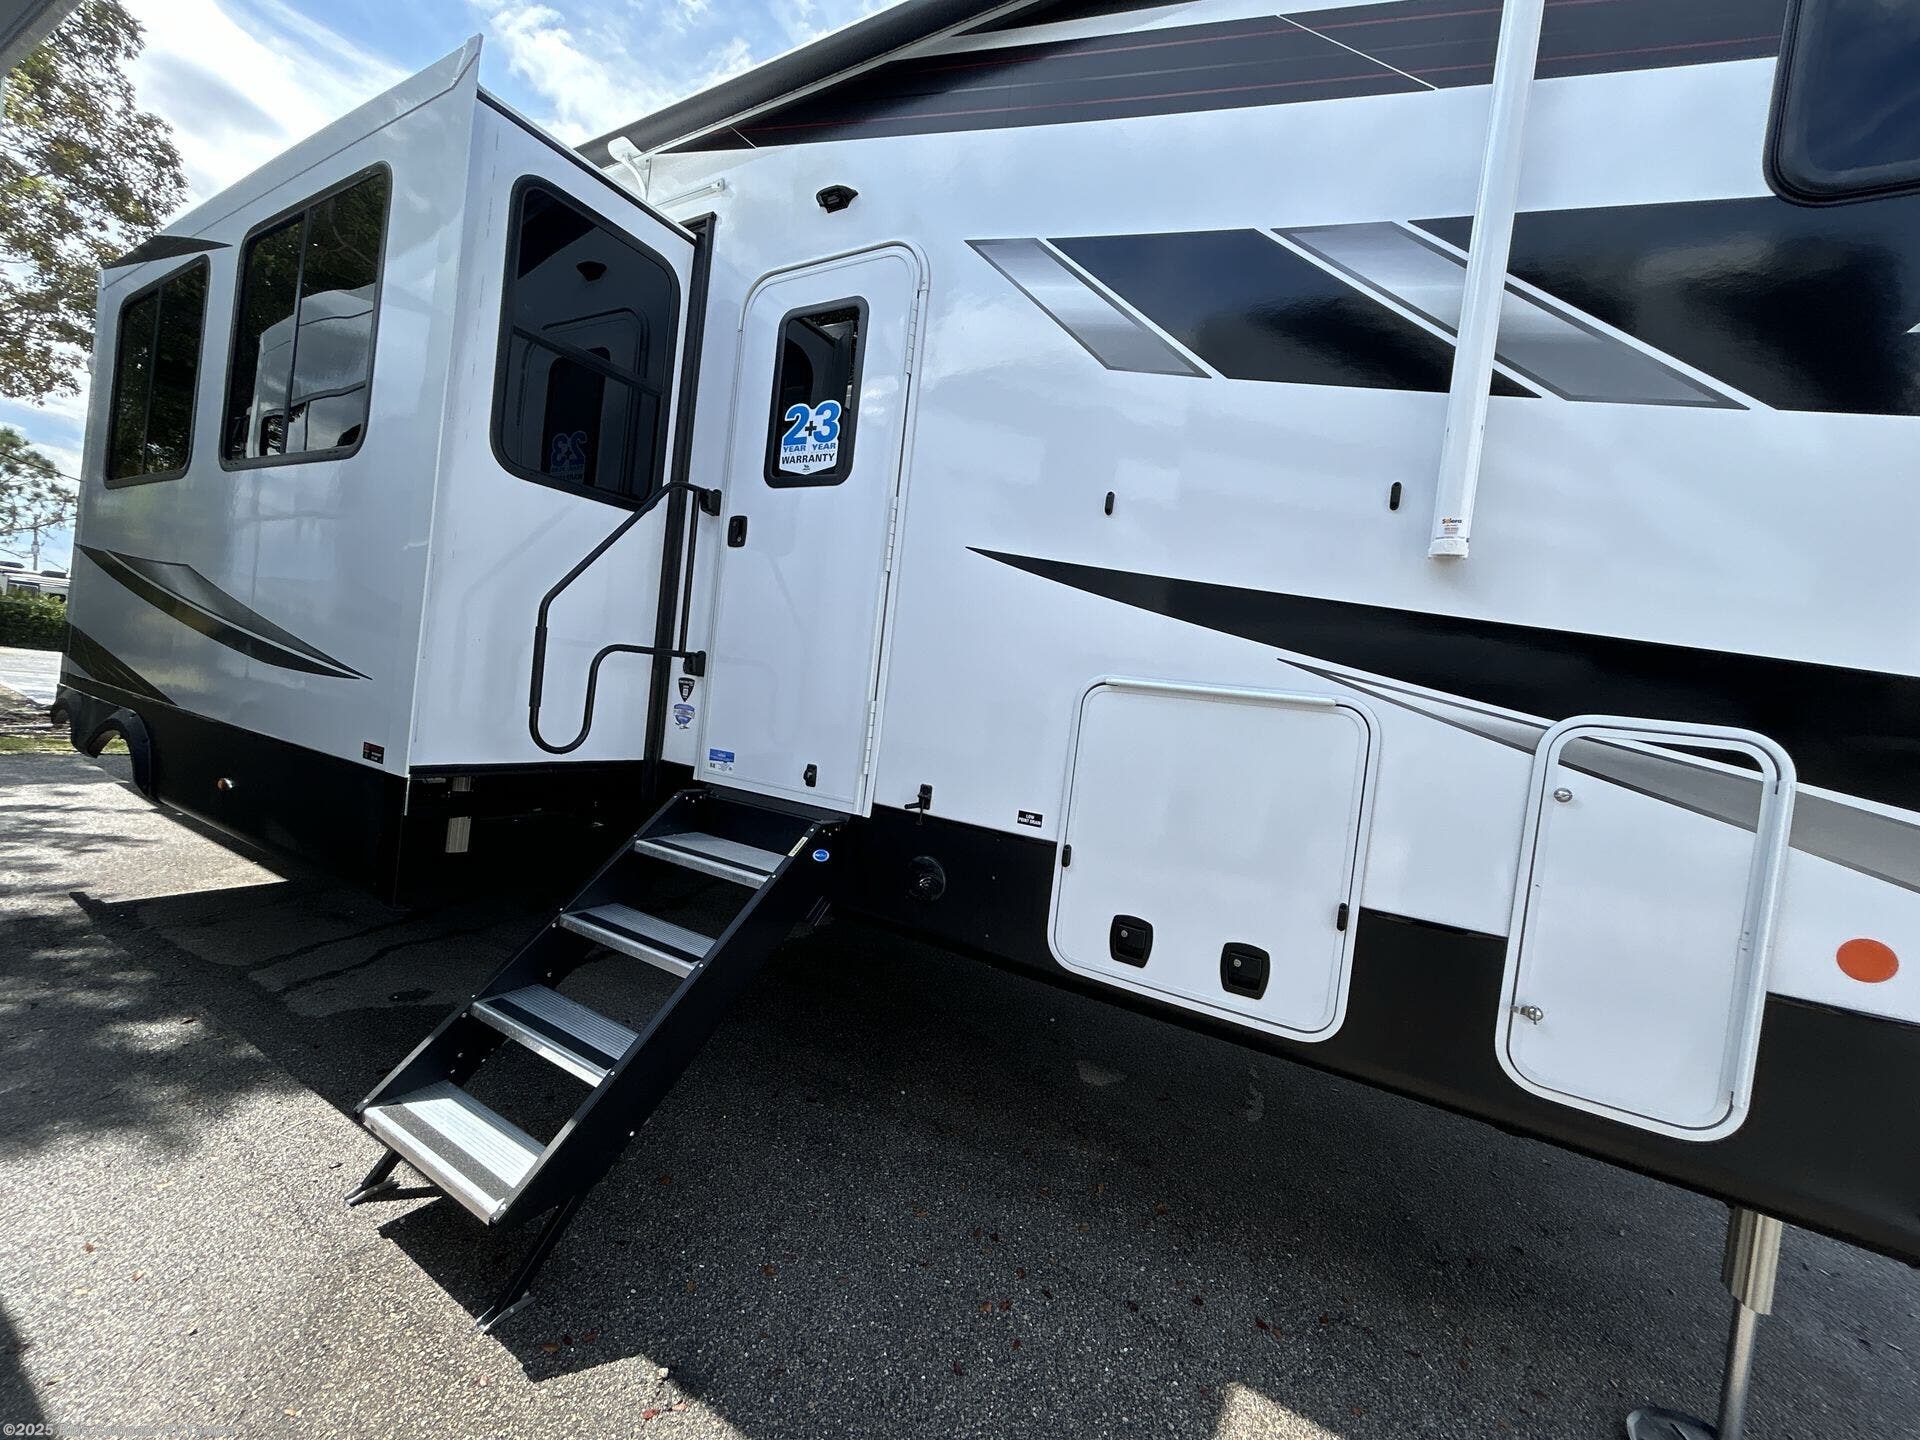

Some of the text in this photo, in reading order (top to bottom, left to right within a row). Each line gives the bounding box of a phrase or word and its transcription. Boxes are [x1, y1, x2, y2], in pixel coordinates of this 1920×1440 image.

[783, 445, 807, 453] YEAR
[812, 442, 836, 451] YEAR
[781, 453, 835, 465] WARRANTY
